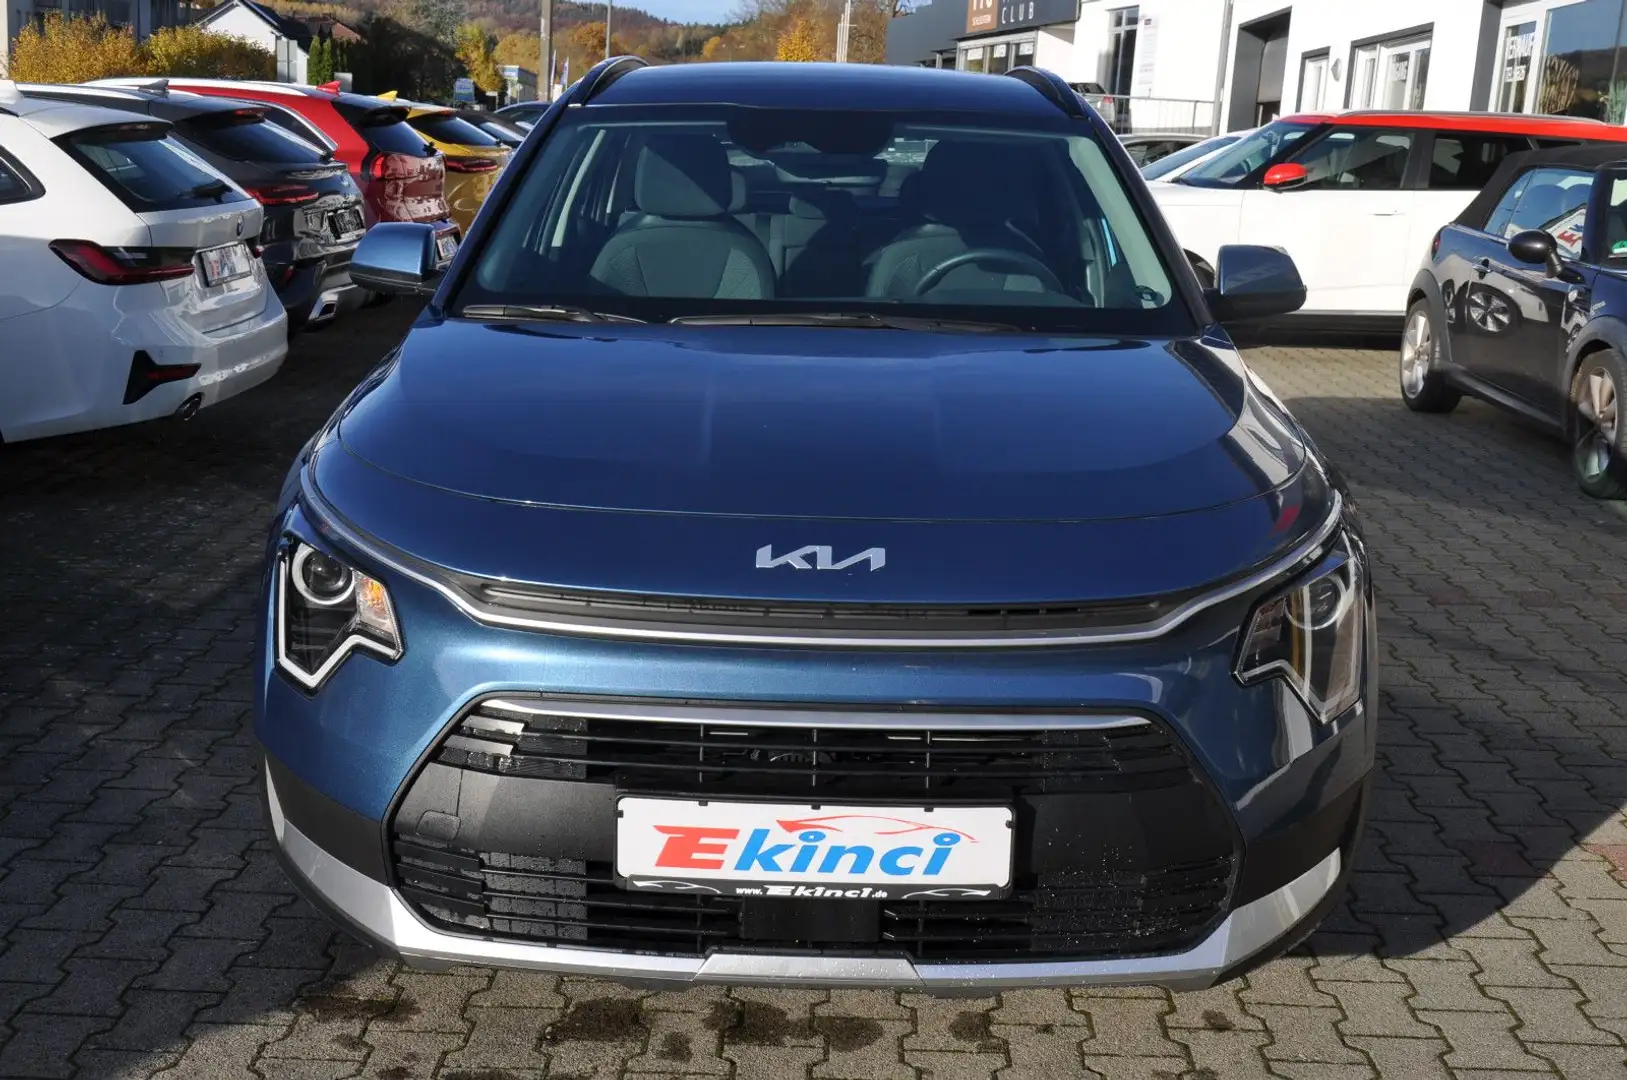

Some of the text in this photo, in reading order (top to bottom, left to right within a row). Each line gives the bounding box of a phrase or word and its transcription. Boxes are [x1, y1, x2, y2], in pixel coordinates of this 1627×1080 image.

[1002, 2, 1034, 24] CLUB
[756, 544, 886, 571] KIA
[653, 824, 962, 876] Ekinci
[736, 885, 888, 899] www.Ekinci.de
